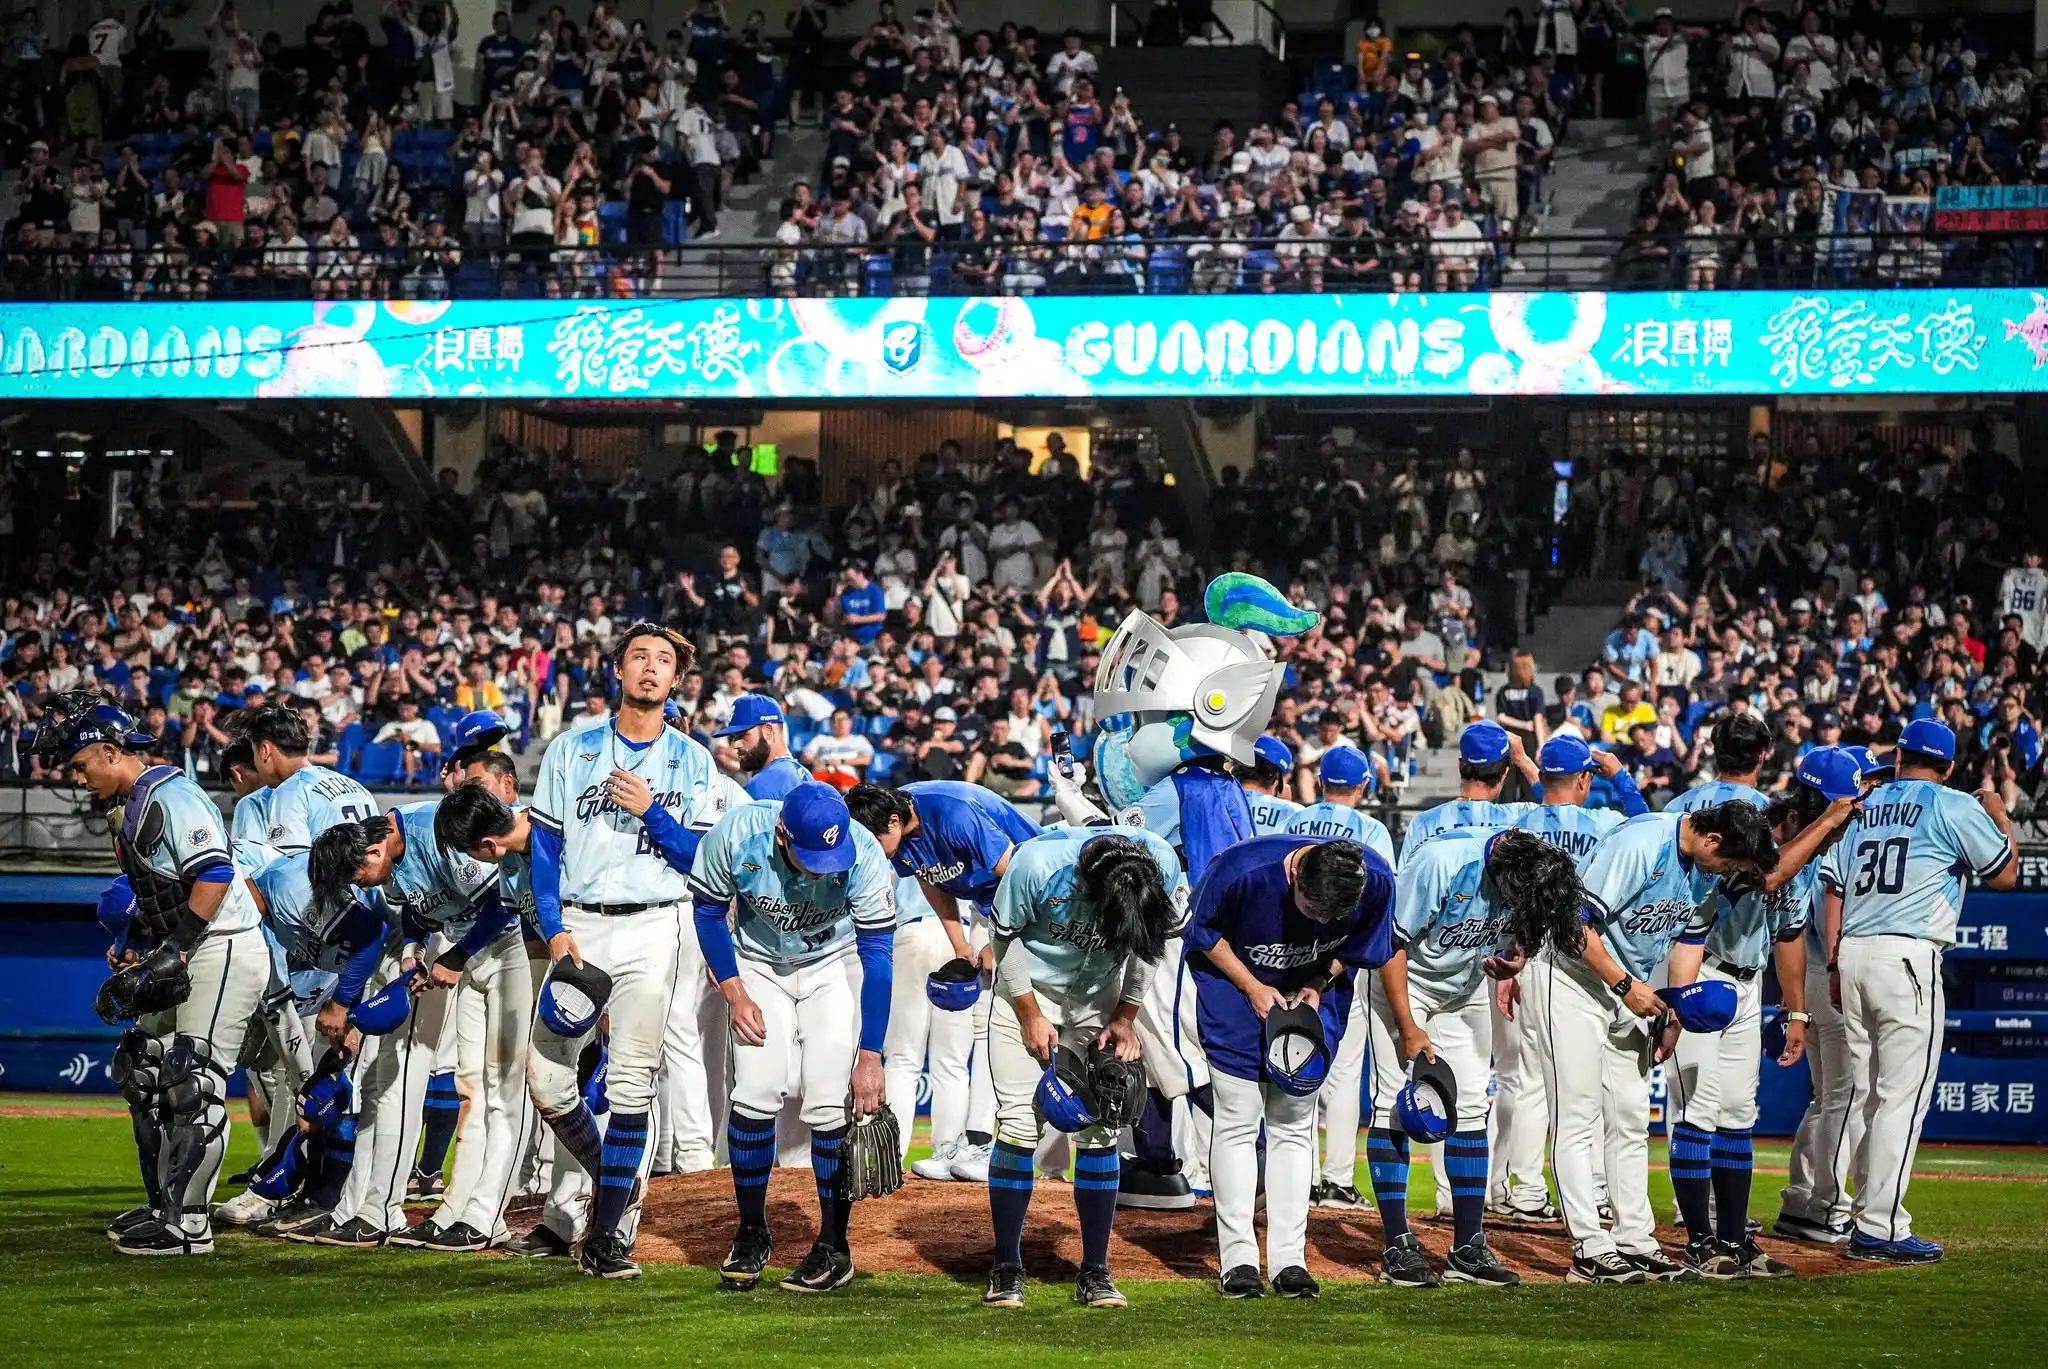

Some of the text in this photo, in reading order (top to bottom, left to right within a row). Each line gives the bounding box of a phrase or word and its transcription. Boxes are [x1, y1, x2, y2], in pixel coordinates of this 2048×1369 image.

[93, 33, 109, 54] 7
[0, 325, 284, 379] ARDIANS
[1066, 318, 1466, 377] GUARDIANS
[1541, 830, 1600, 857] OYAMA
[1854, 836, 1911, 897] 30
[755, 895, 801, 915] Fubon
[368, 995, 389, 1009] momo
[1936, 1082, 2036, 1114] 稻家居
[266, 1168, 285, 1185] momo
